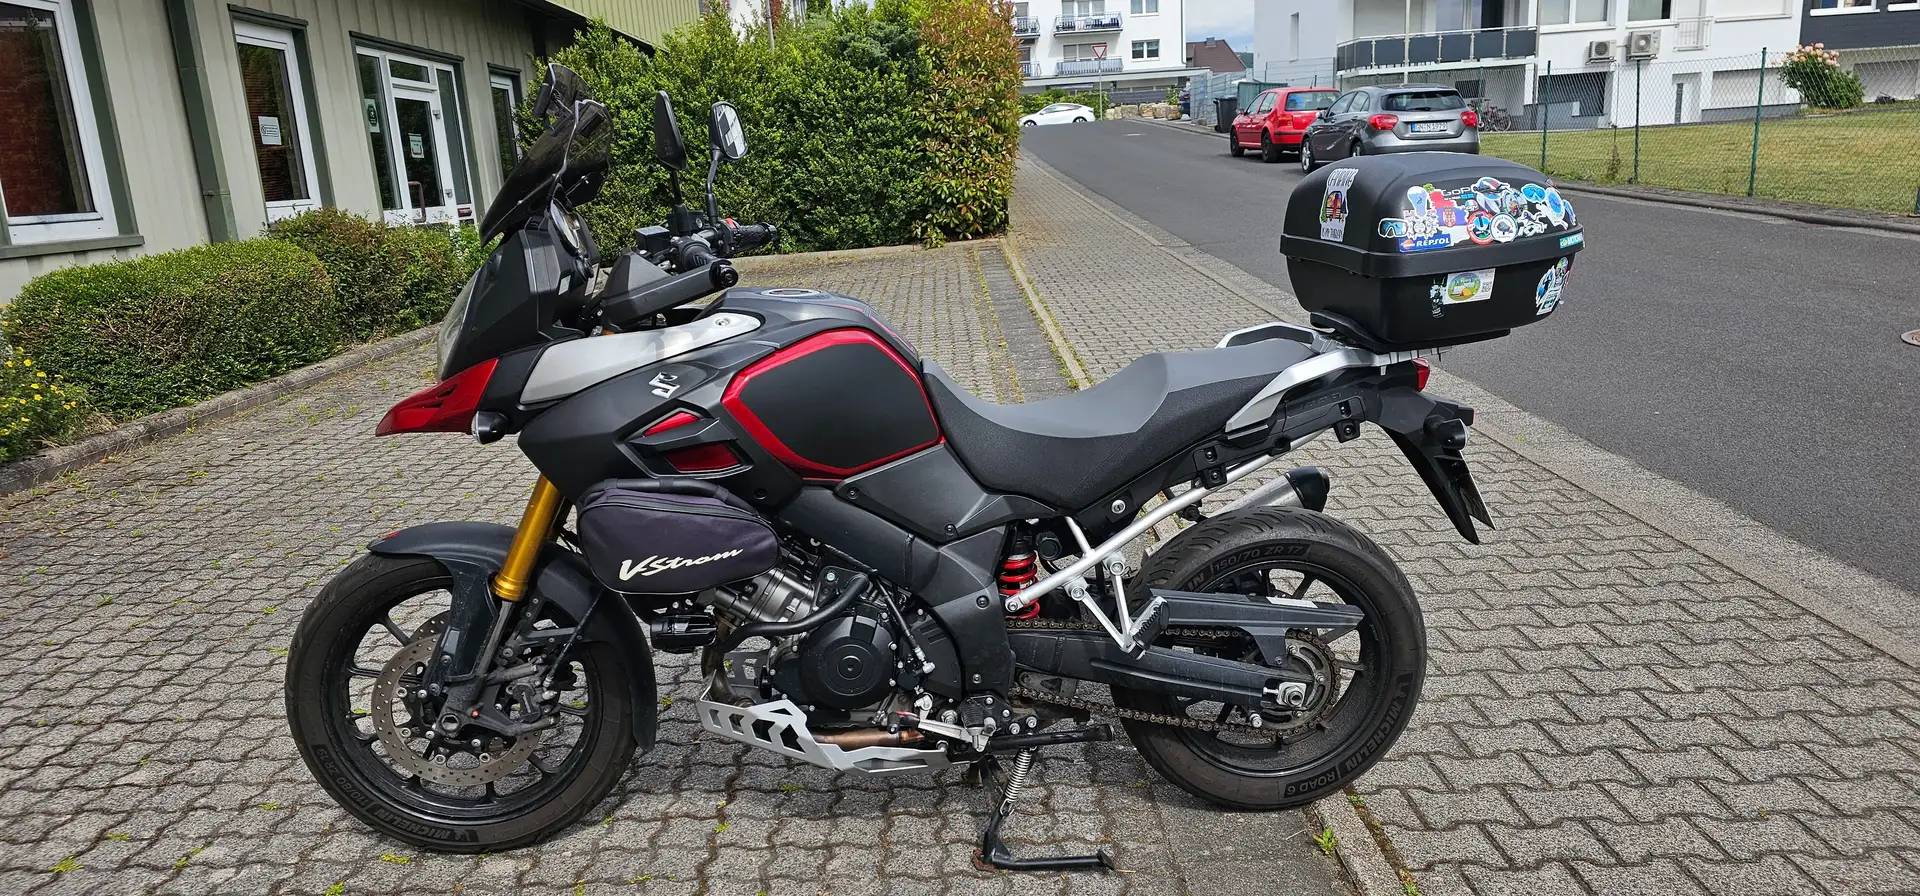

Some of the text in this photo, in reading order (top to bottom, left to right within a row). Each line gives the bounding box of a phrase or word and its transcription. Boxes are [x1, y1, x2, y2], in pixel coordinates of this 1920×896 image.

[1416, 237, 1450, 247] REPSOL
[1214, 545, 1304, 573] 150/70 ZR 17
[1345, 700, 1402, 773] MICHELIN
[324, 763, 337, 776] ZR
[1300, 771, 1336, 791] ROAD
[336, 777, 370, 810] 110/80
[372, 808, 451, 840] MICHELIN
